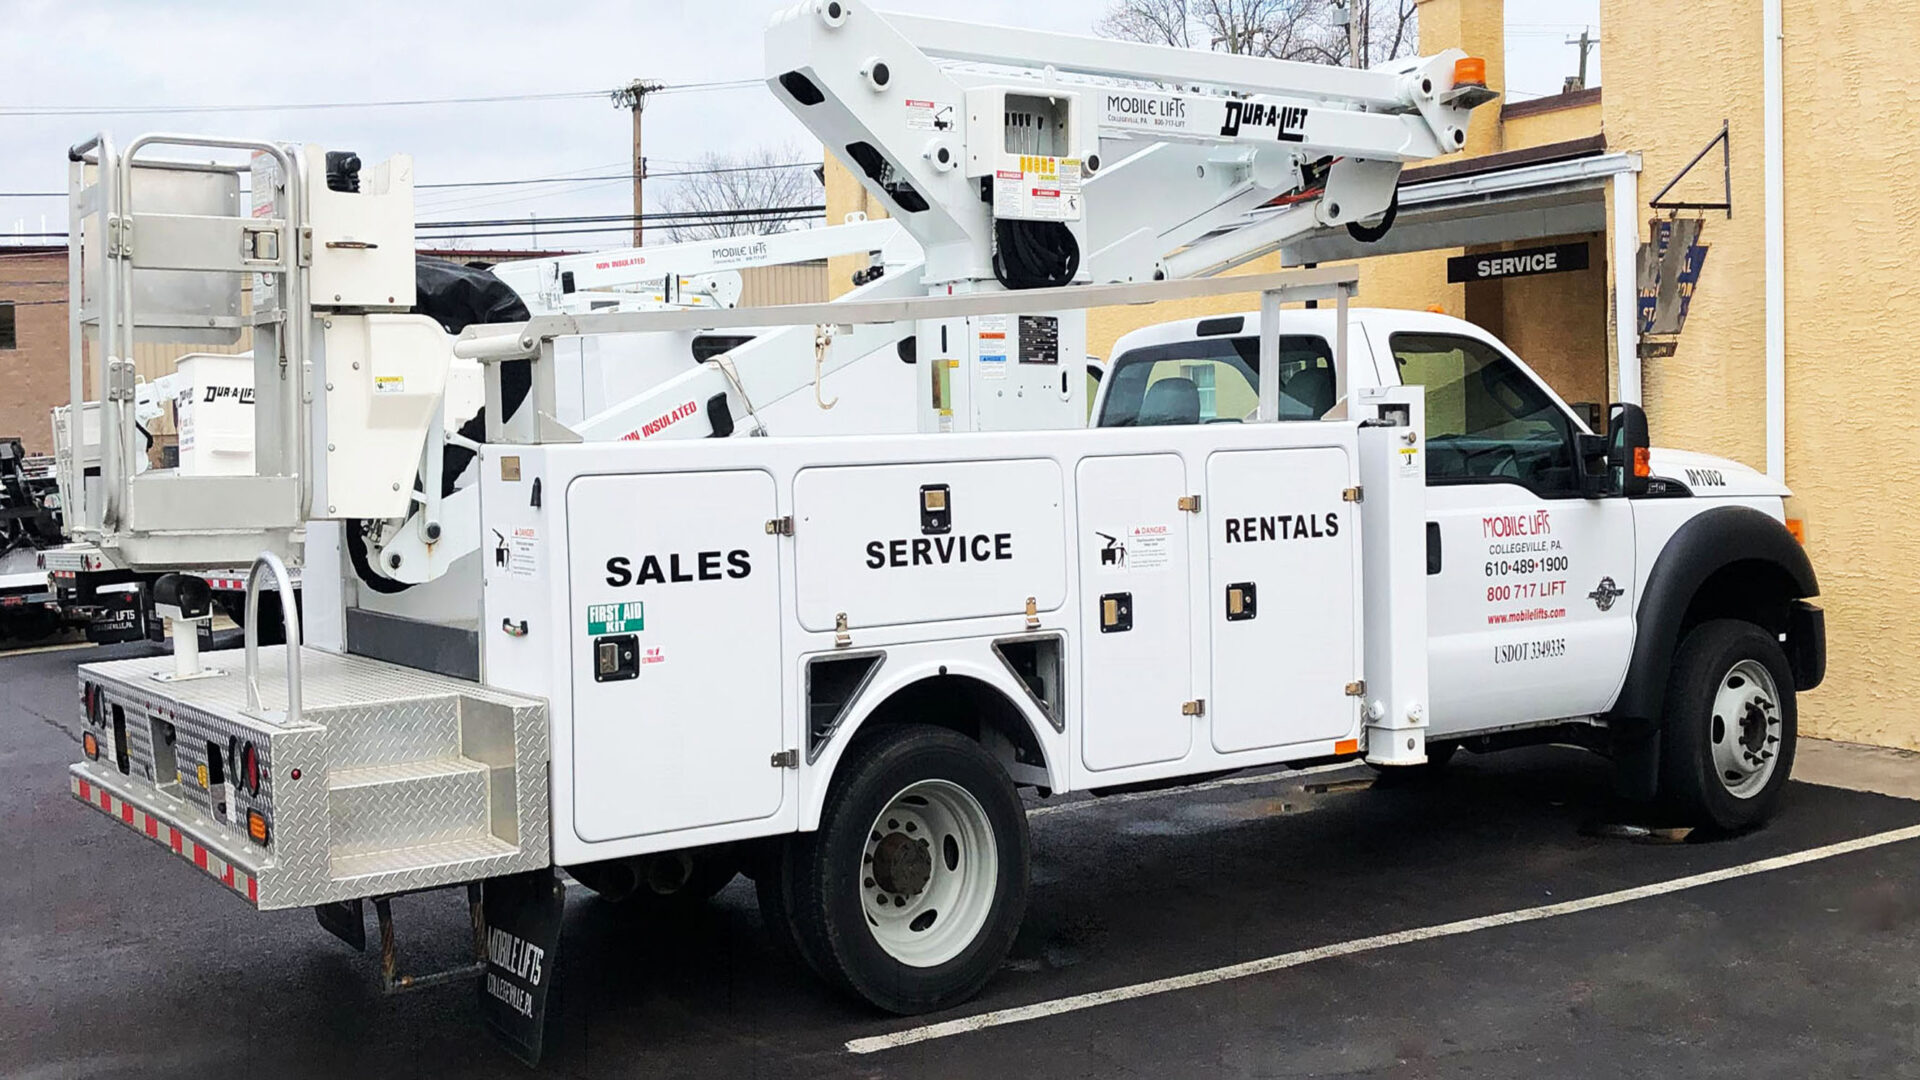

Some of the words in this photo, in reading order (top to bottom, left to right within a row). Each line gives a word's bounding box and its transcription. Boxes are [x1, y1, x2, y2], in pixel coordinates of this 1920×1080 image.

[1107, 95, 1157, 115] MOBILE
[1160, 97, 1186, 118] LIFTS
[596, 262, 610, 270] NON
[612, 257, 645, 269] INSULATED
[1477, 252, 1557, 277] SERVICE
[641, 401, 697, 438] INSULATED
[1684, 468, 1726, 487] M1002
[1141, 526, 1166, 534] DANGER
[1226, 512, 1339, 543] RENTALS
[1482, 514, 1527, 538] MOBILE
[1528, 509, 1550, 535] LIFTS
[866, 533, 1013, 569] SERVICE
[1489, 541, 1549, 555] COLLEGEVILLE,
[1551, 540, 1563, 550] PA.
[605, 549, 751, 587] SALES
[1487, 586, 1511, 602] 800
[1514, 583, 1537, 599] 717
[1540, 580, 1566, 597] LIFT
[116, 610, 136, 621] LIFTS
[589, 604, 620, 623] FIRST
[623, 602, 642, 620] AID
[1488, 607, 1566, 624] www.mobilelifts.com
[605, 620, 626, 633] KIT
[1494, 642, 1529, 664] USDOT
[1530, 638, 1566, 660] 3349335
[487, 925, 520, 974] MOBILE
[517, 940, 545, 986] LIFTS
